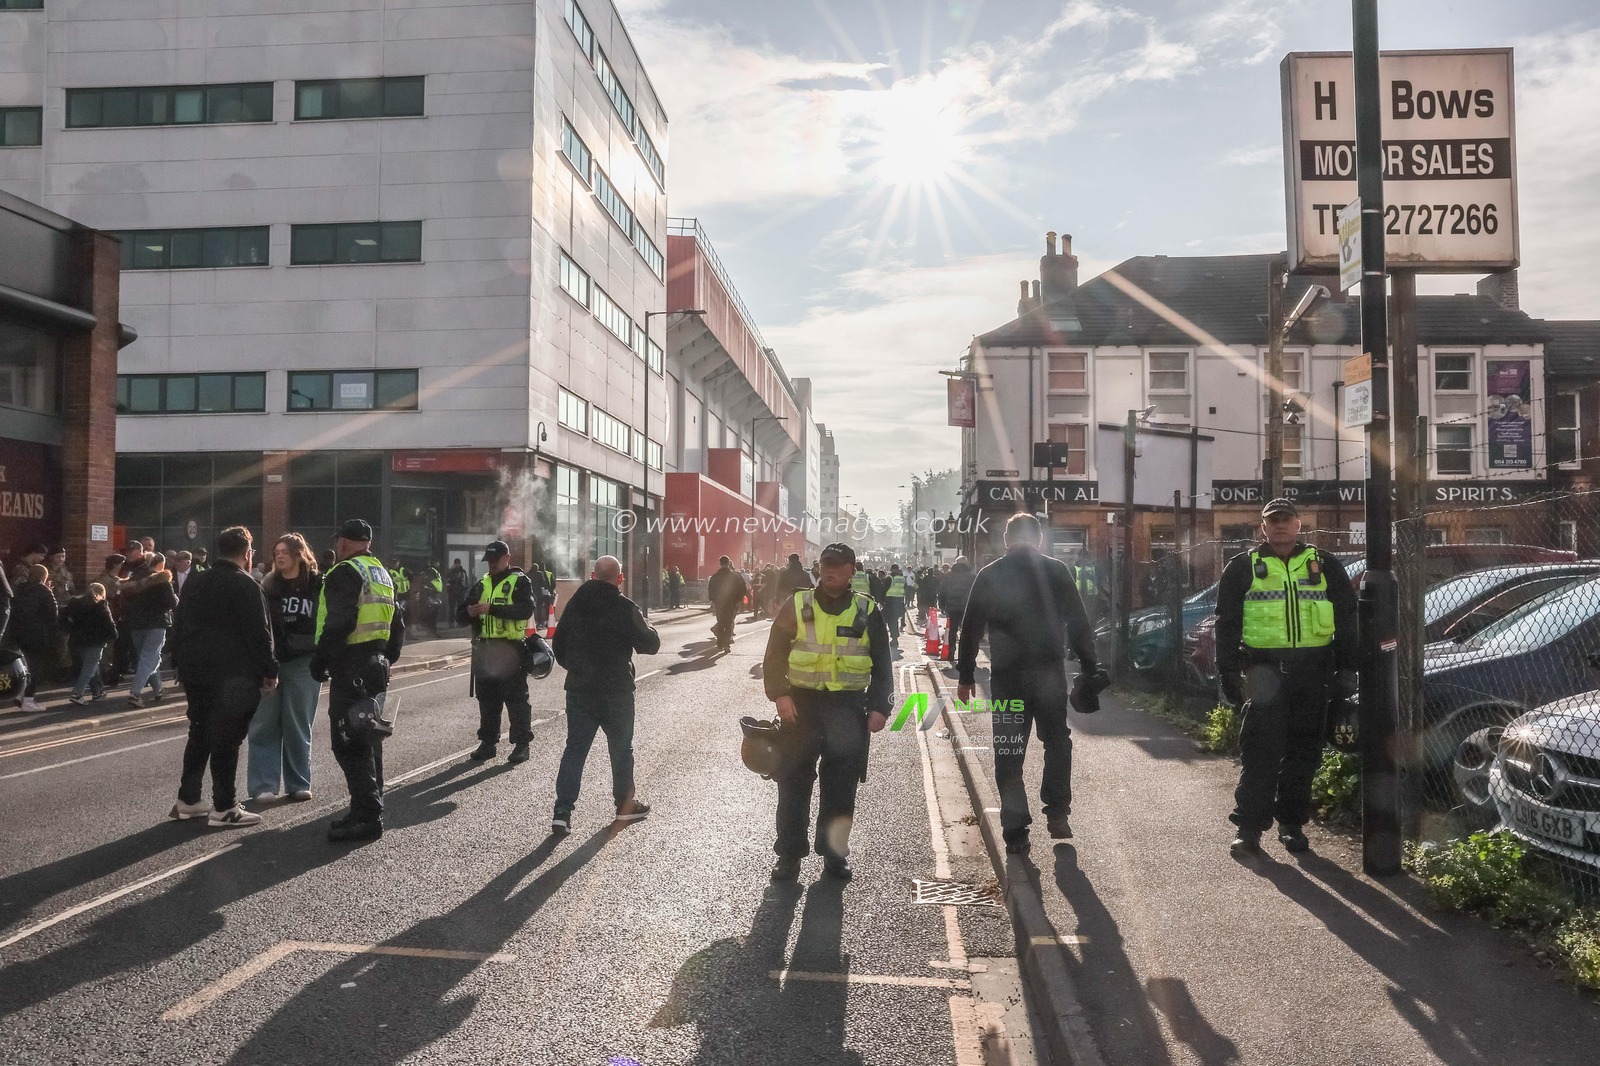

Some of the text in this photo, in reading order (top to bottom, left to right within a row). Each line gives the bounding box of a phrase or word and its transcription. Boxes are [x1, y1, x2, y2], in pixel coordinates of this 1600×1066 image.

[1314, 80, 1494, 120] H Bows
[1314, 143, 1494, 176] MOR SALES
[1312, 204, 1347, 235] TE
[1384, 203, 1498, 235] 2727266
